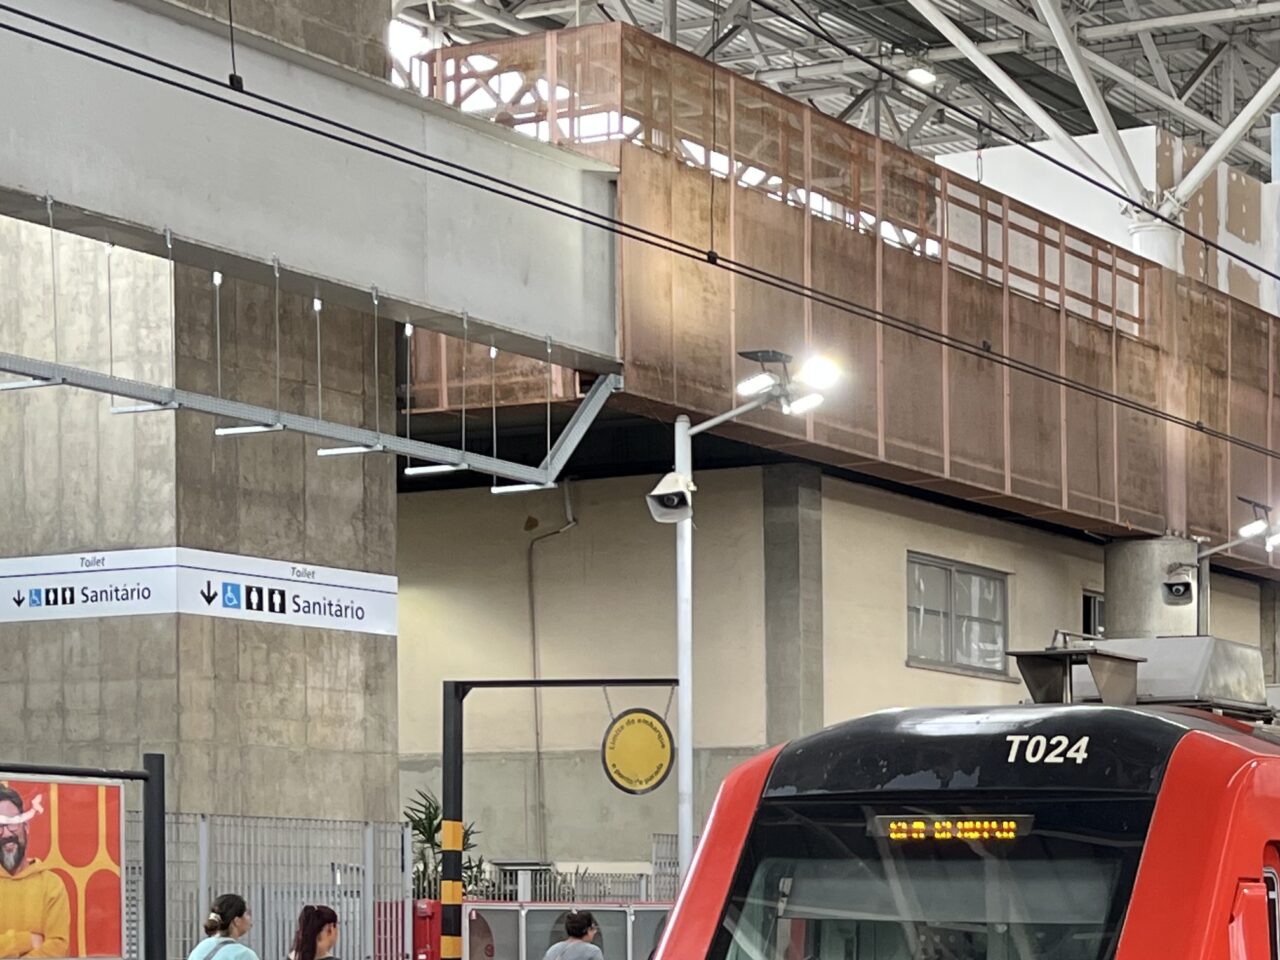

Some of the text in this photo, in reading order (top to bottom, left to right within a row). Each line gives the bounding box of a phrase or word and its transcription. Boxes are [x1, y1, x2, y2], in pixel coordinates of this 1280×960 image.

[80, 556, 106, 568] Toilet
[291, 566, 316, 580] Toilet
[80, 583, 152, 604] Sanitário
[291, 594, 366, 621] Sanitário
[1005, 734, 1090, 764] T024
